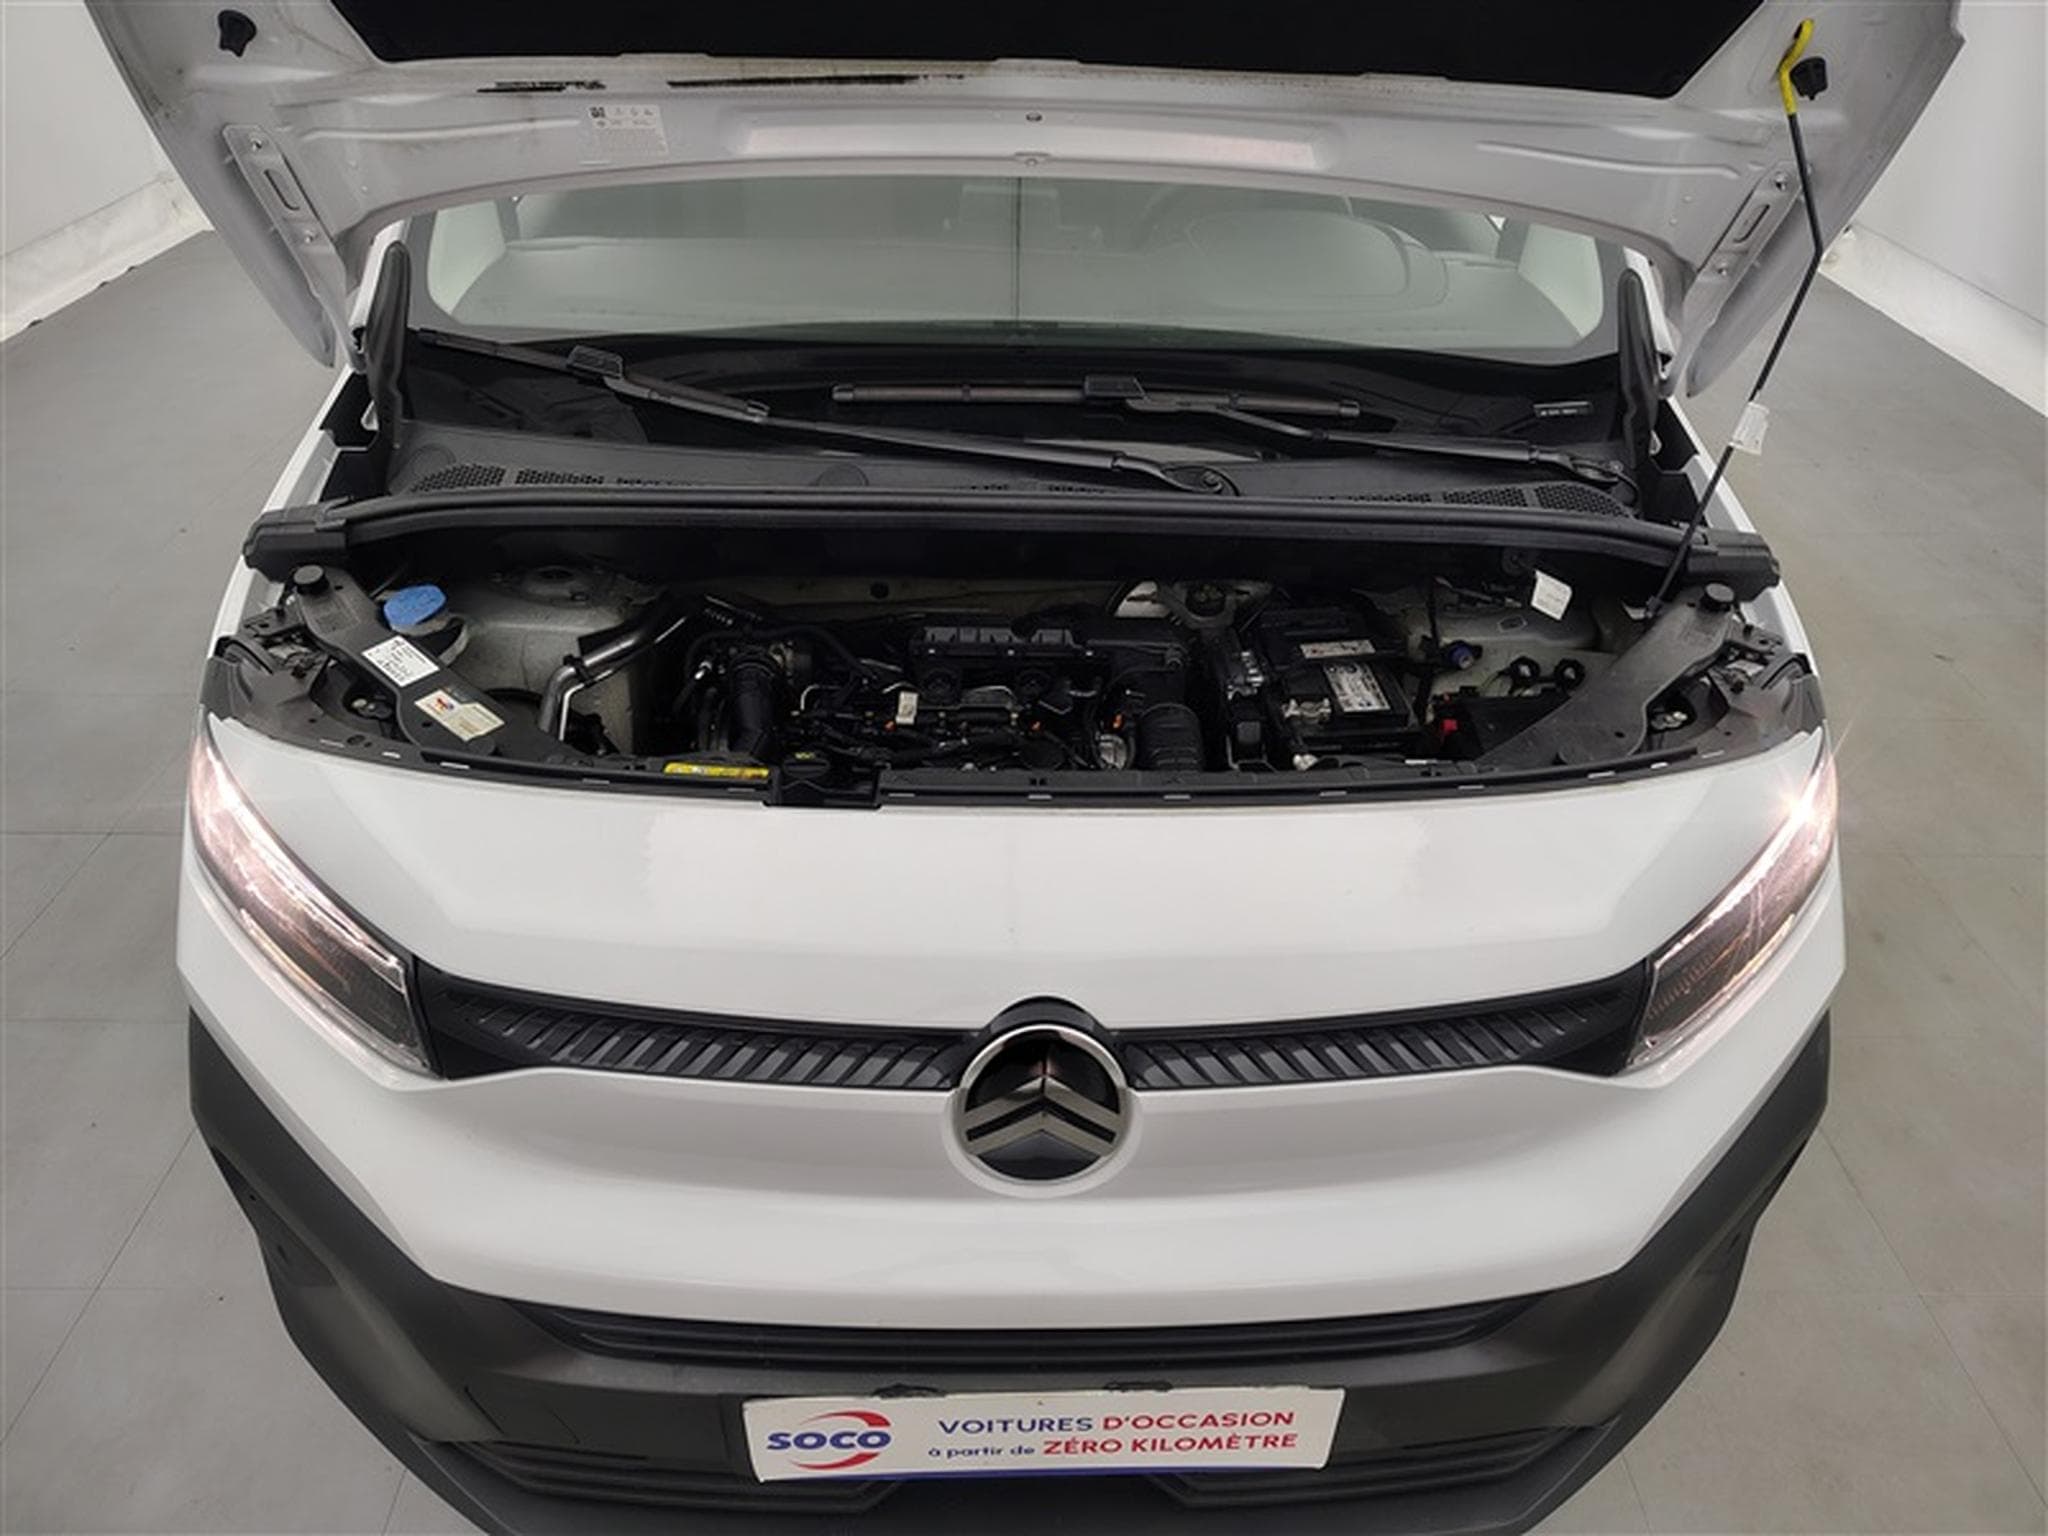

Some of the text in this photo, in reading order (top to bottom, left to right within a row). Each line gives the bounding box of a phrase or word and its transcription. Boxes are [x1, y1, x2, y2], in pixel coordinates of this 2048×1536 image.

[938, 1411, 1294, 1435] VOITURES D'OCCASION
[766, 1431, 892, 1451] SOCO
[947, 1446, 1002, 1459] partir
[1010, 1445, 1035, 1455] de
[1043, 1437, 1122, 1455] ZÉRO
[1131, 1432, 1298, 1453] KILOMÈTRE
